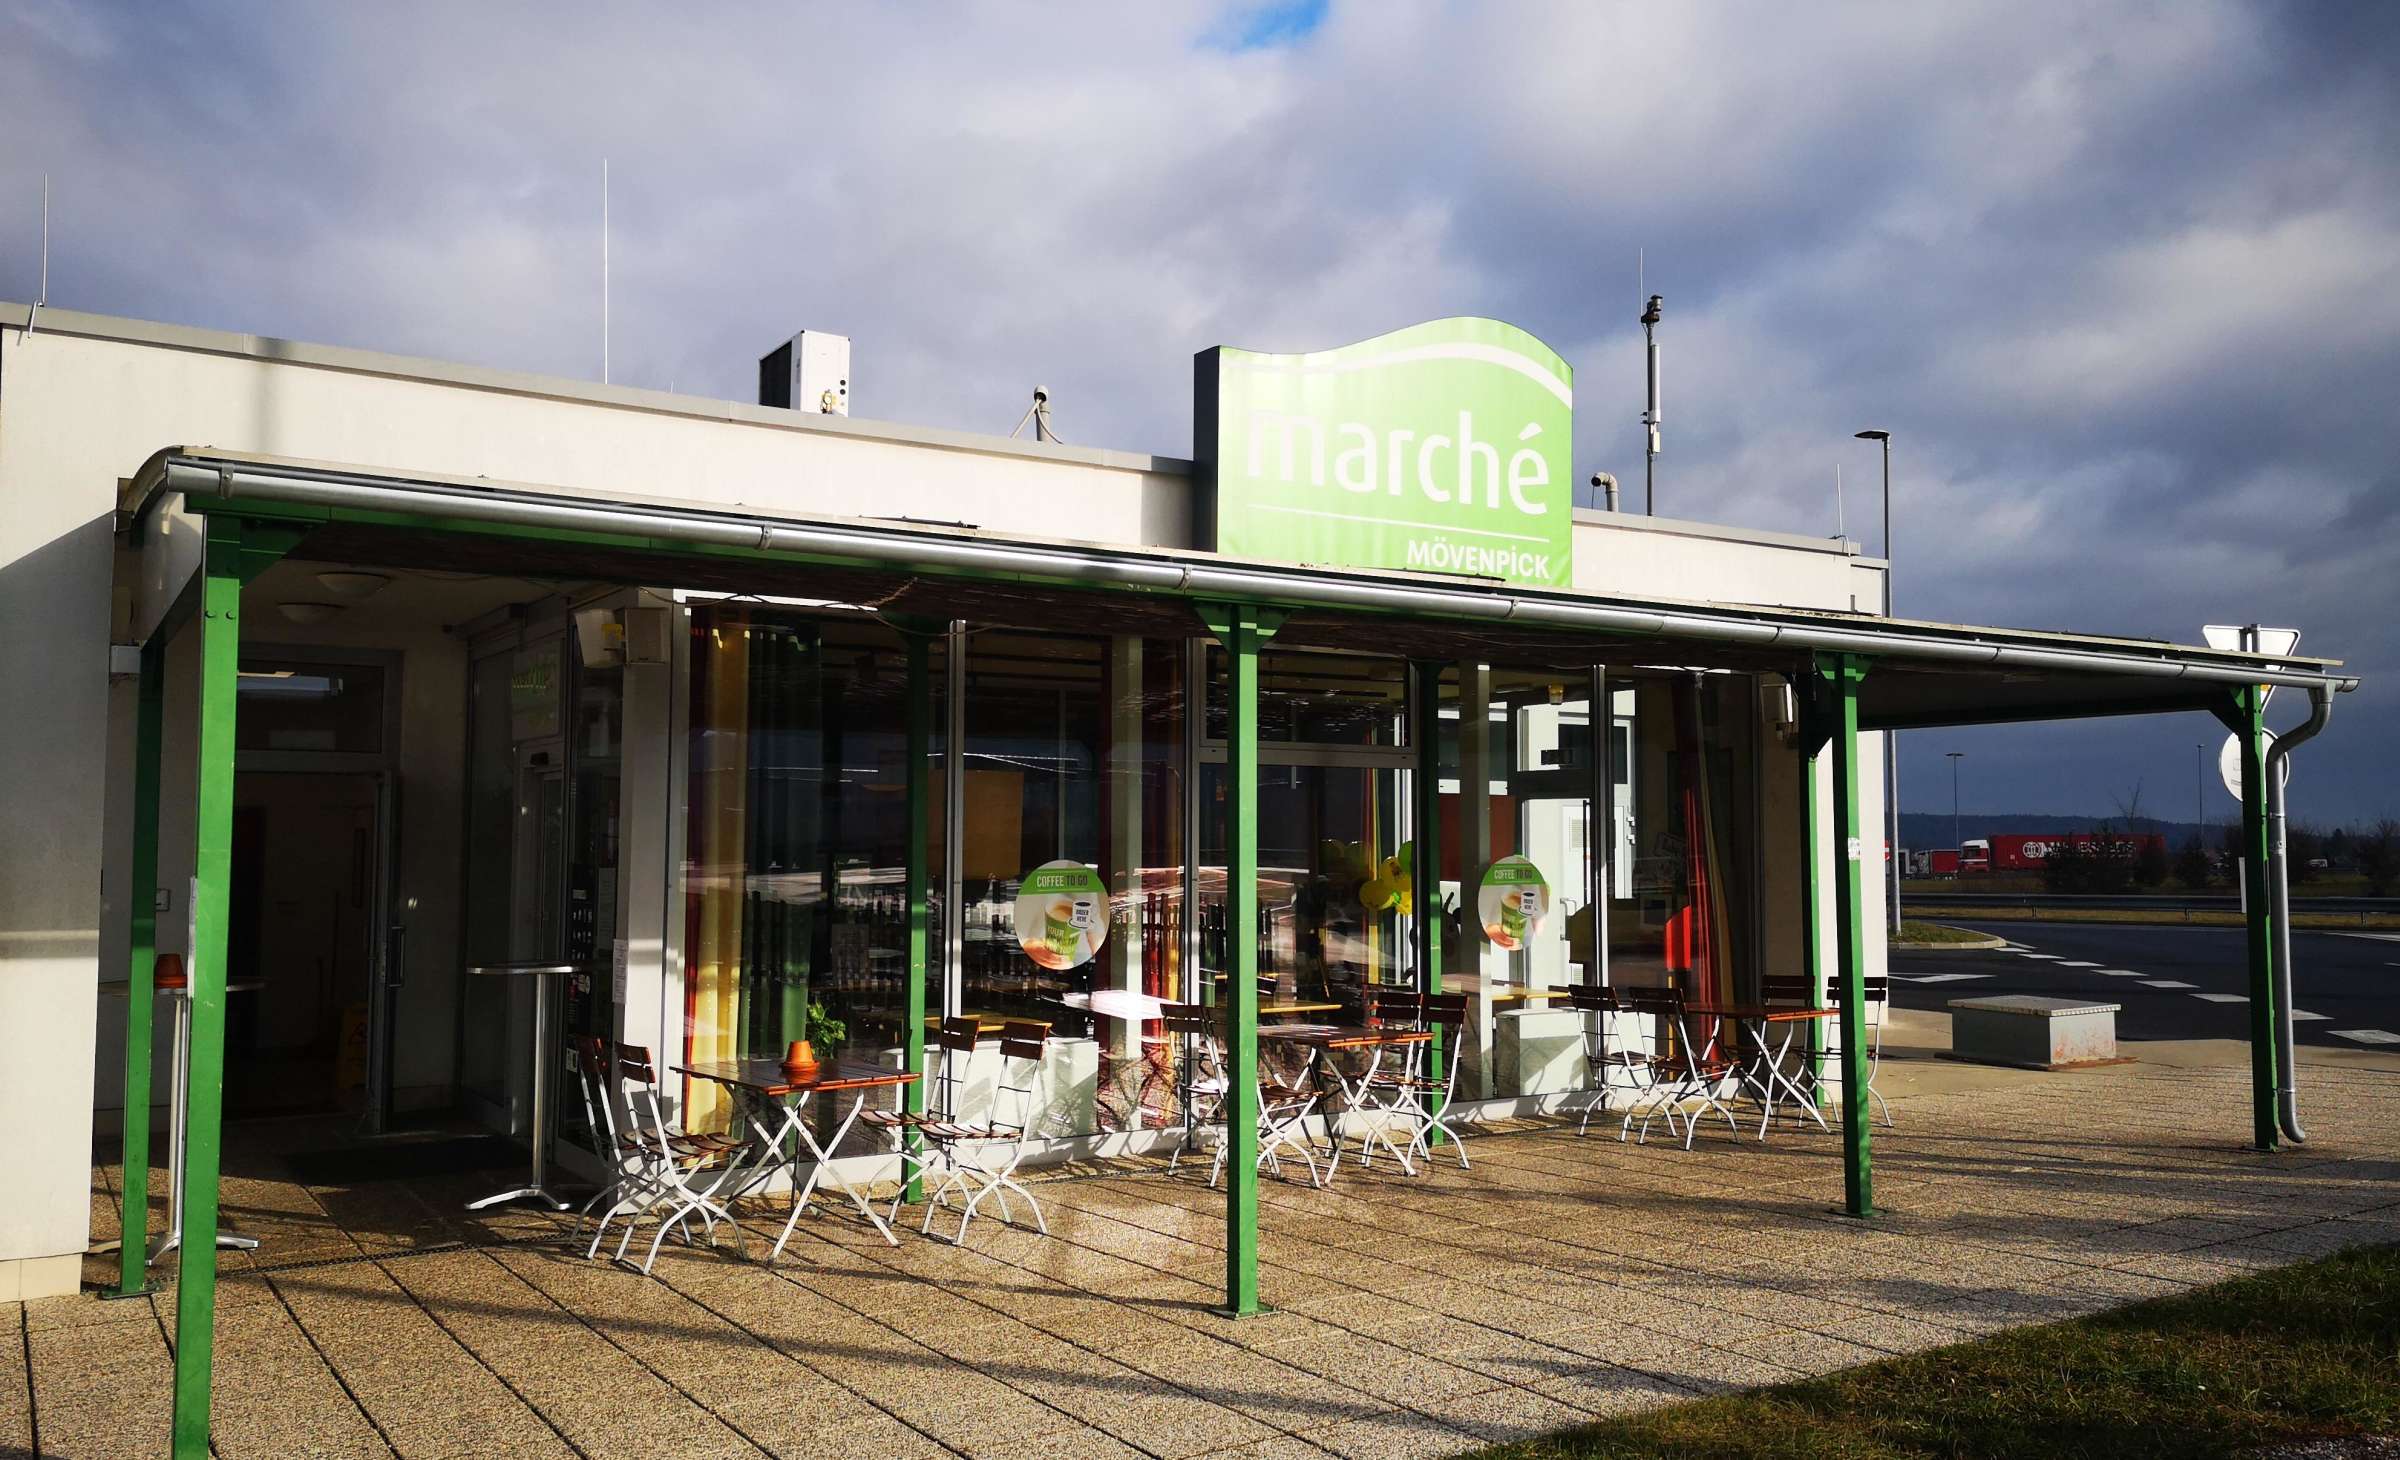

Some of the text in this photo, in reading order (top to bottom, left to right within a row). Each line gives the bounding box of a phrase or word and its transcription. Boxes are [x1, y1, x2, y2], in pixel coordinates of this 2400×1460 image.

[1248, 411, 1550, 514] marché
[1407, 536, 1550, 579] MÖVENPICK
[1036, 875, 1064, 888] COFFEE
[1494, 869, 1515, 880] COFFEE
